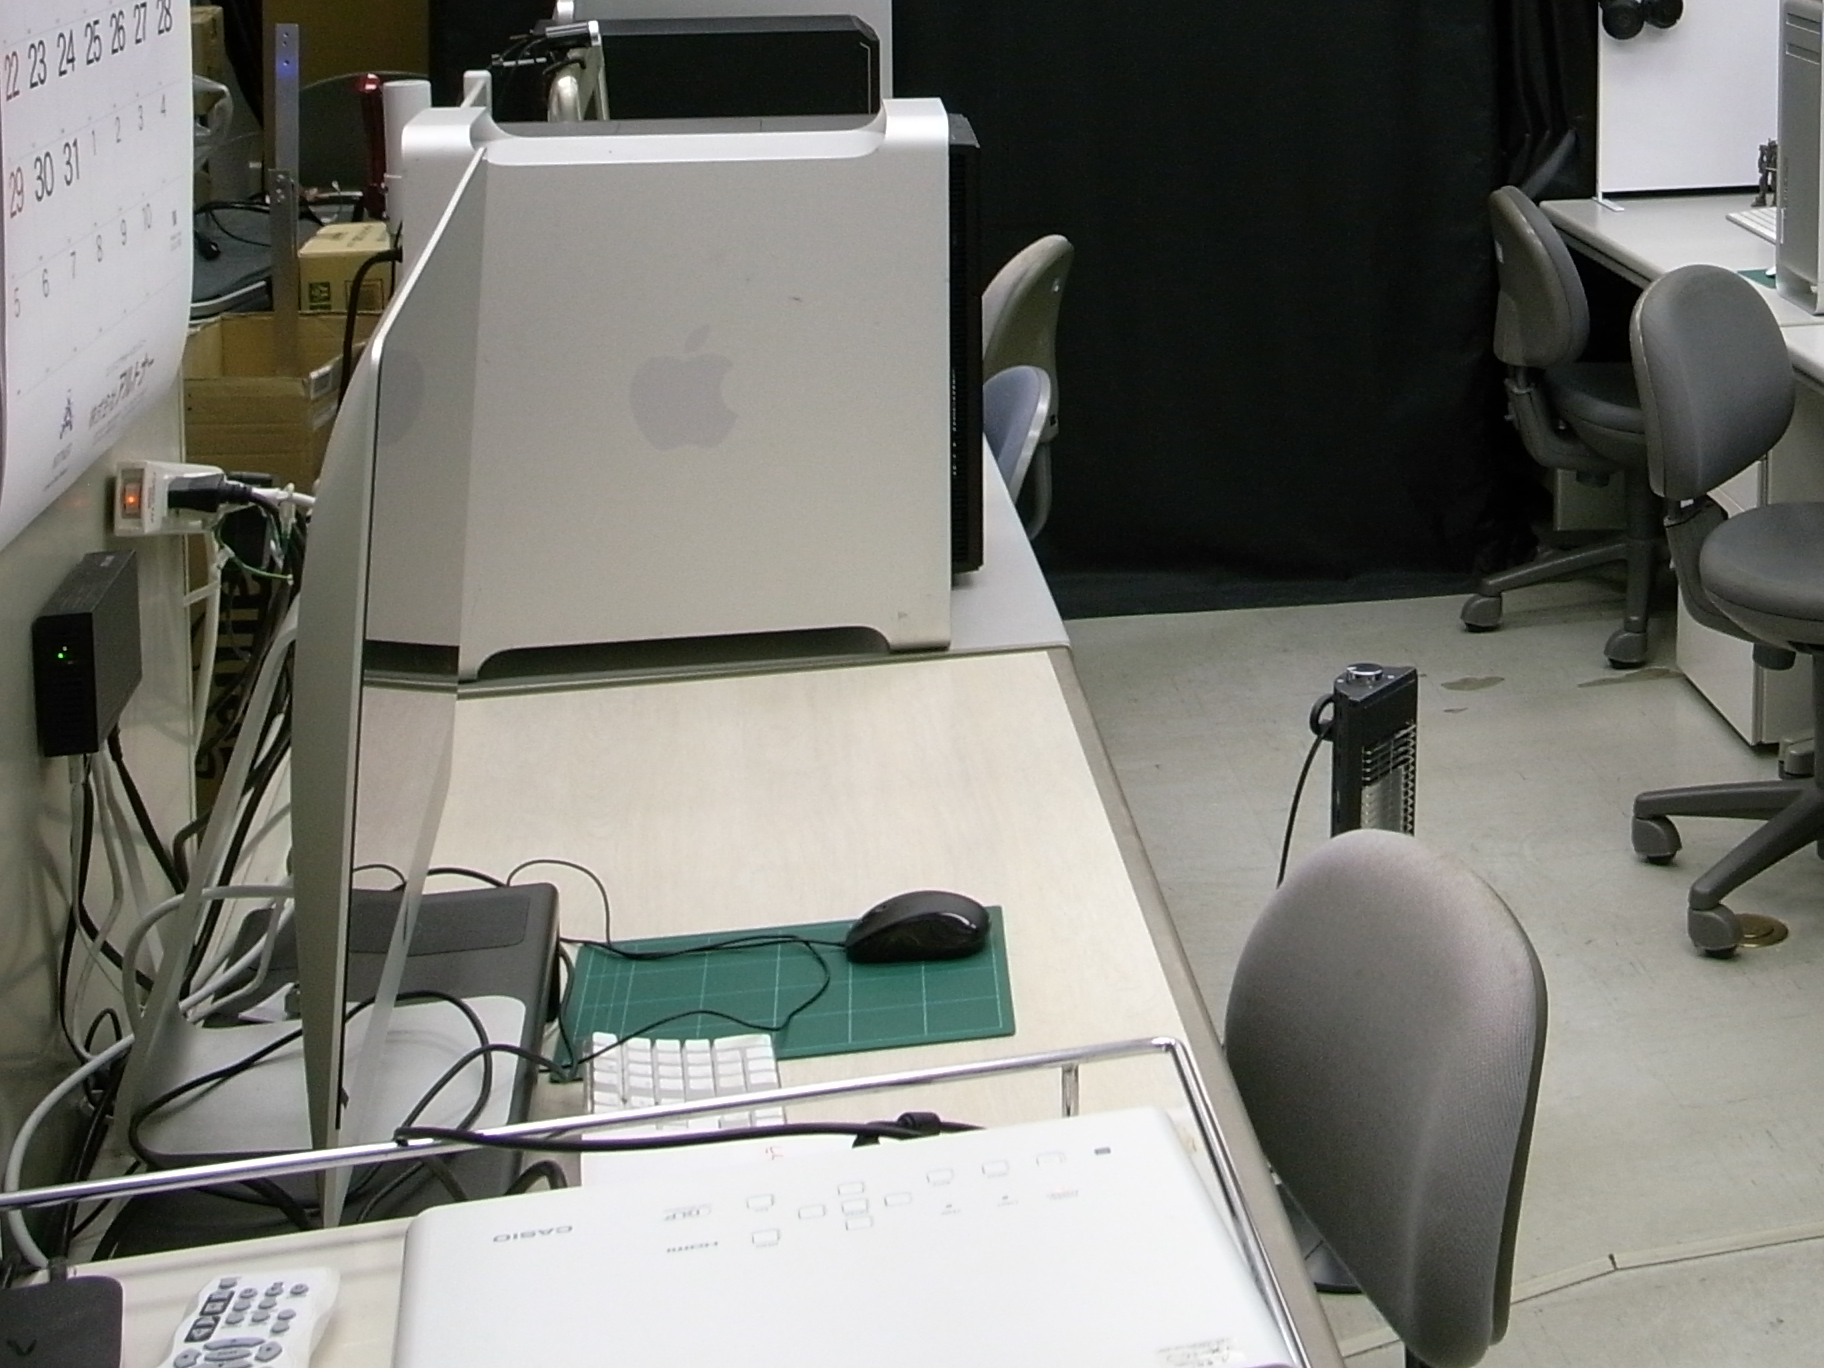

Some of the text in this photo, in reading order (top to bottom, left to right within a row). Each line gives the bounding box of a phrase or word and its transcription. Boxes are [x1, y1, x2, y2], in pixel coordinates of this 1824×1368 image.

[4, 50, 20, 102] 22
[28, 39, 47, 89] 23
[56, 28, 76, 78] 24
[84, 18, 103, 66] 25
[109, 9, 126, 55] 26
[133, 1, 148, 45] 27
[9, 165, 24, 219] 29
[33, 150, 55, 203] 30
[62, 137, 80, 186] 31
[493, 1225, 573, 1243] CASIO
